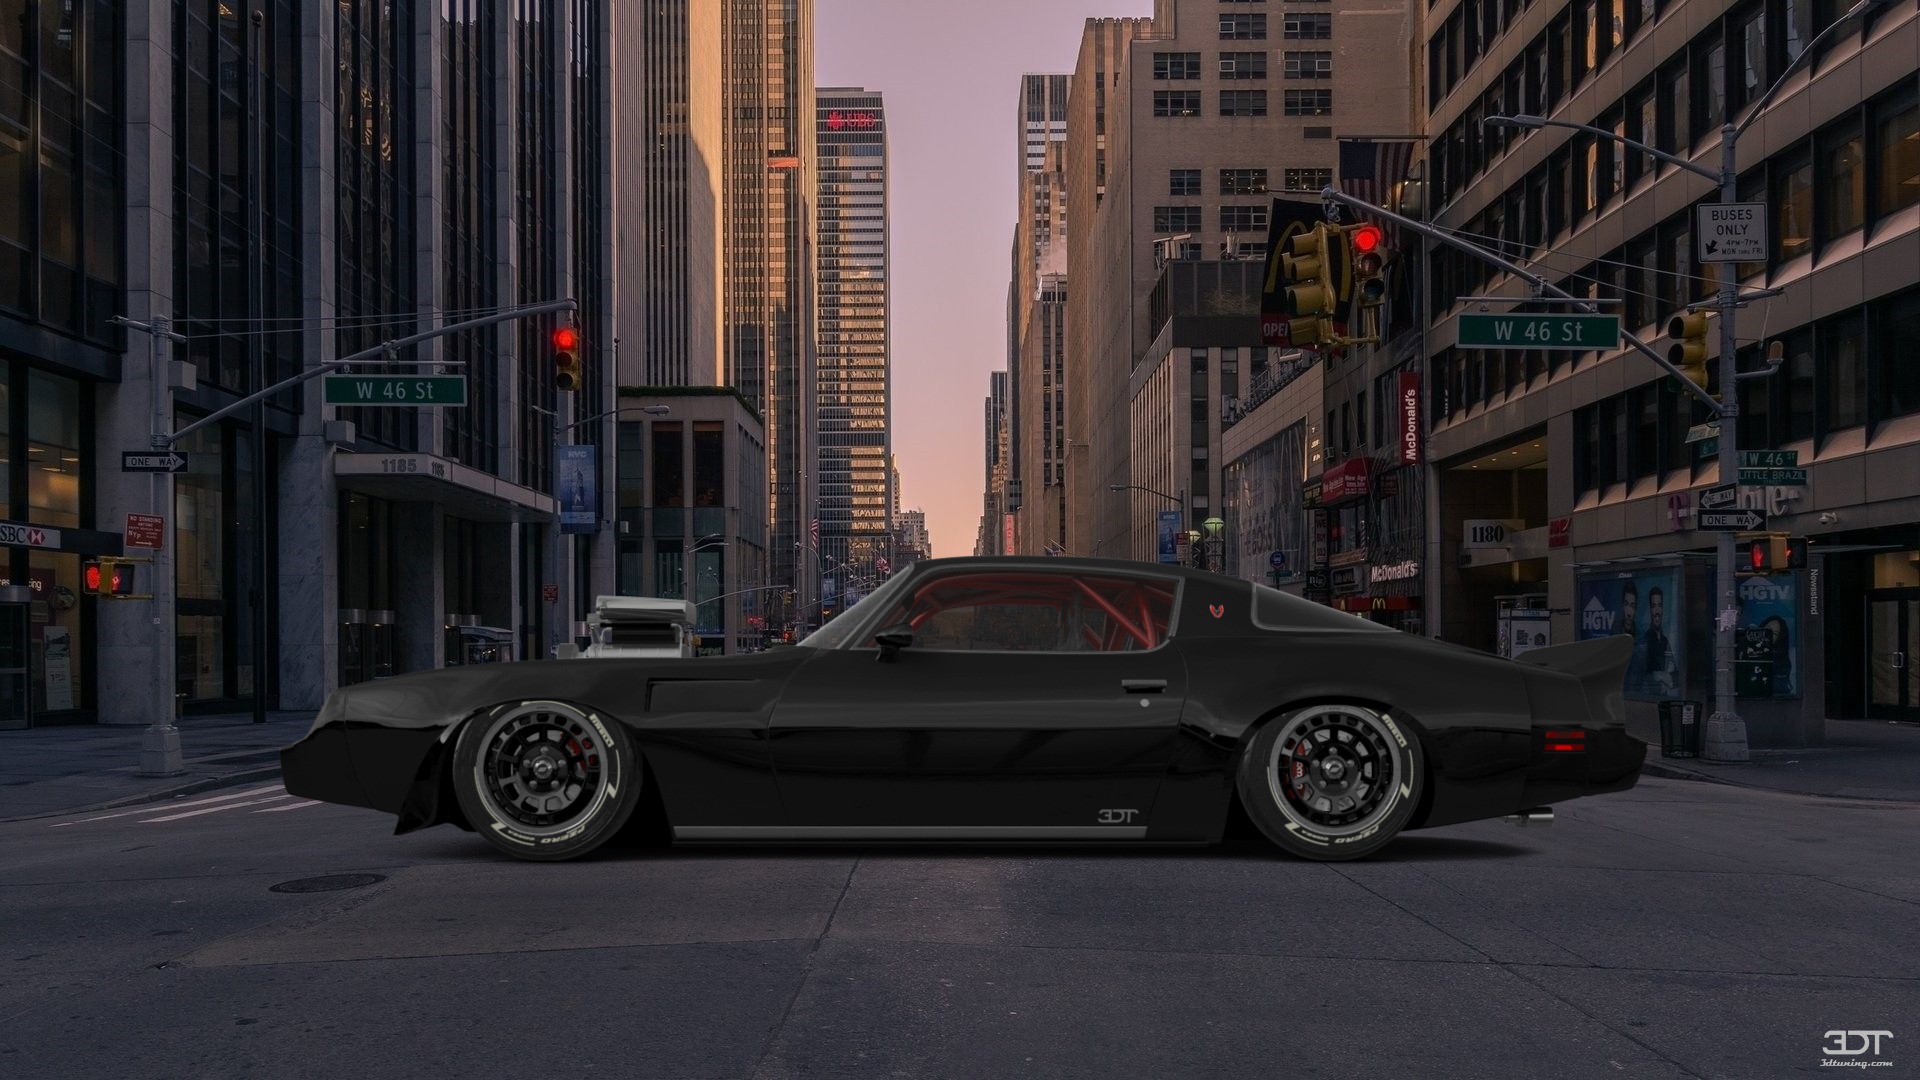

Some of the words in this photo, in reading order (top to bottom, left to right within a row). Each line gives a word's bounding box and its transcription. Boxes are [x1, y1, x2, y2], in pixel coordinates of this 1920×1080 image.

[1712, 210, 1753, 221] BUSES
[1716, 225, 1748, 235] ONLY
[1494, 321, 1514, 341] W
[1524, 321, 1550, 341] 46
[1561, 321, 1583, 342] St
[356, 381, 373, 399] W
[383, 381, 406, 399] 46
[415, 381, 434, 399] St
[1405, 389, 1416, 460] McDonald's
[131, 457, 150, 465] ONE
[159, 457, 178, 465] WAY
[382, 459, 416, 472] 1185
[1749, 452, 1760, 466] W
[1765, 452, 1784, 466] 46
[1739, 470, 1768, 480] LITTLE
[1772, 470, 1806, 480] BRAZIL
[1705, 493, 1716, 505] ONE
[1719, 489, 1734, 502] WAY
[1707, 515, 1727, 525] ONE
[1736, 515, 1757, 525] WAY
[1472, 525, 1504, 543] 1180
[1371, 560, 1420, 583] McDonald's
[1740, 585, 1791, 600] HGTV
[1583, 610, 1616, 630] HGTV
